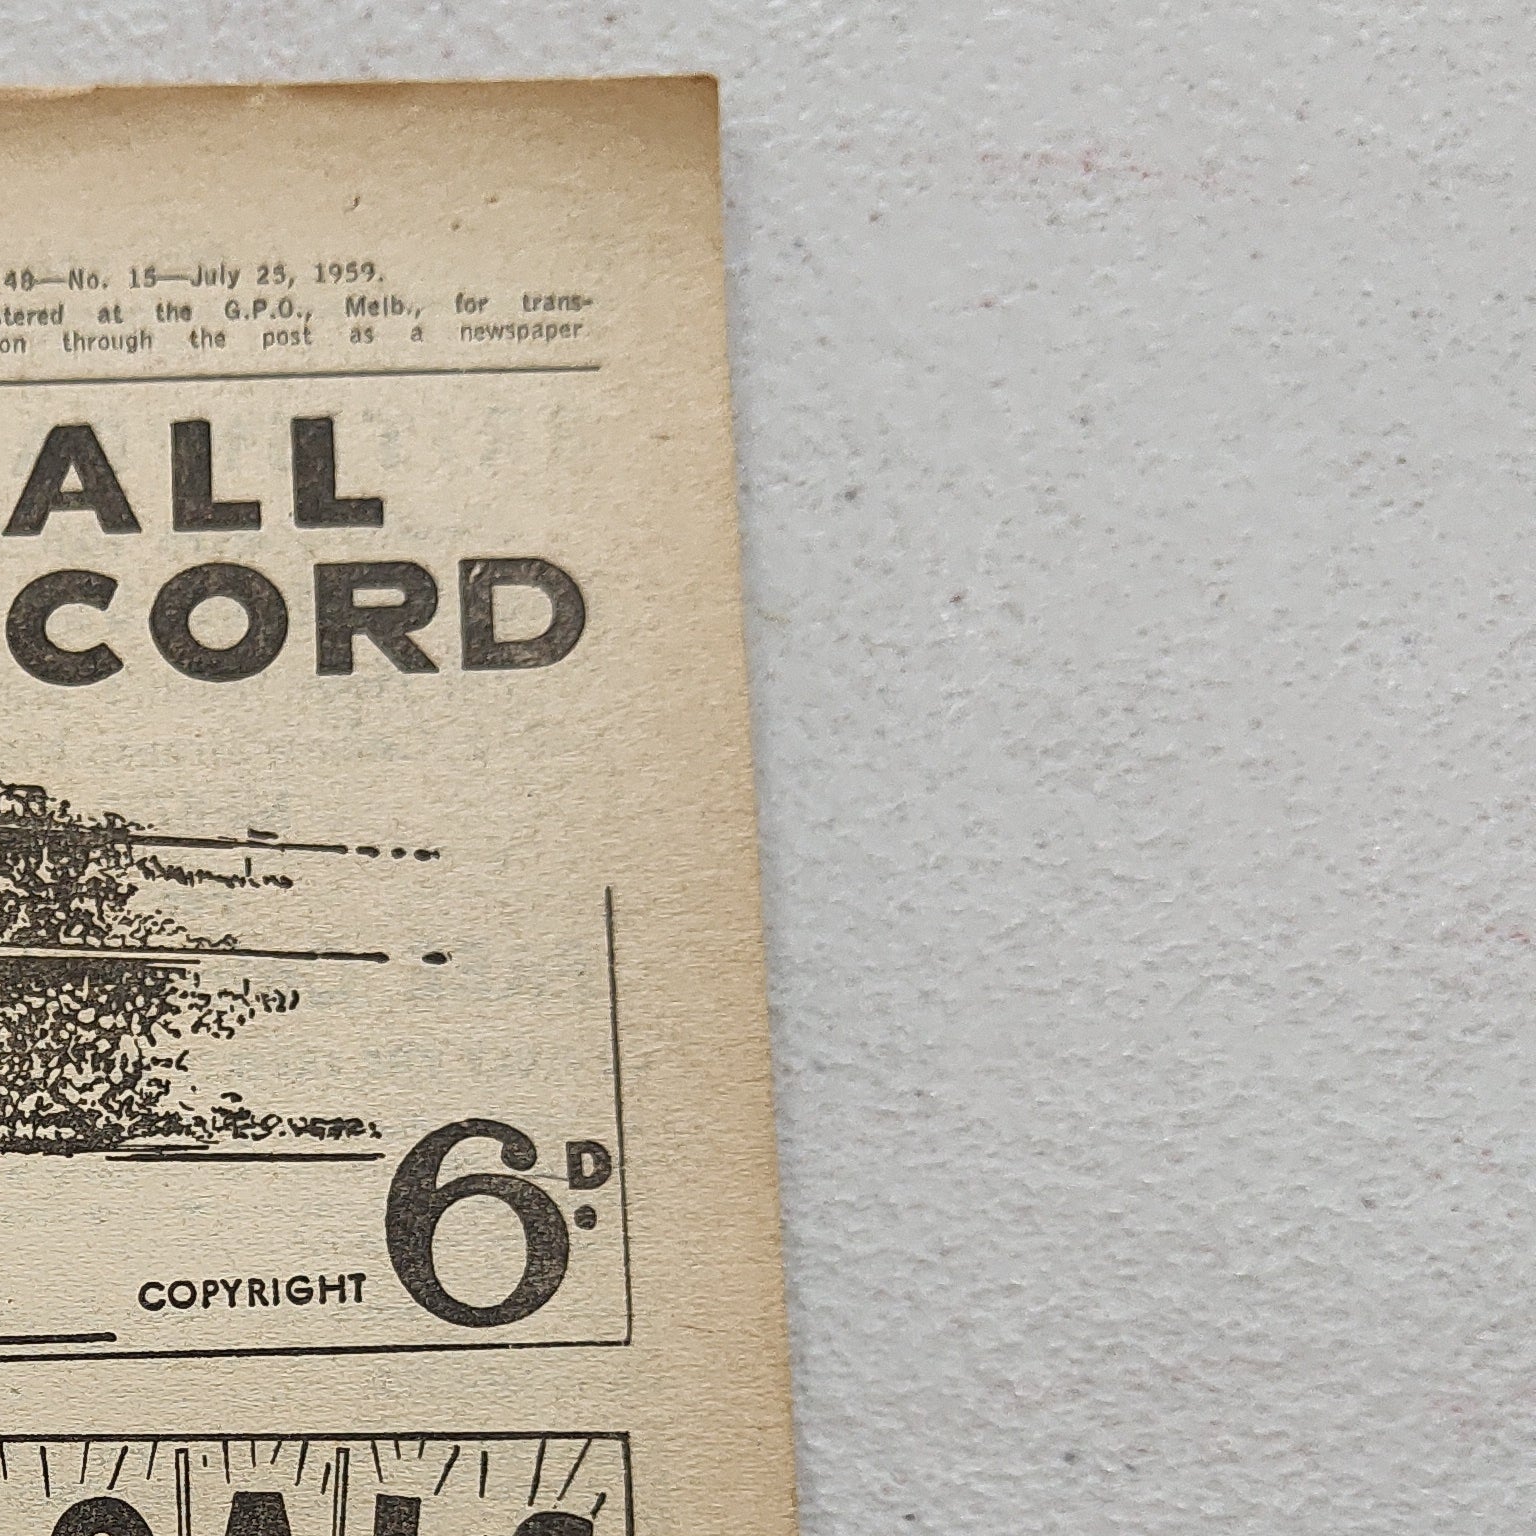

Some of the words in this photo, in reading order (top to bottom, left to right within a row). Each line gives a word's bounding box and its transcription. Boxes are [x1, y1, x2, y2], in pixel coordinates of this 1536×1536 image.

[314, 260, 384, 284] 1959.
[97, 303, 124, 324] at
[155, 300, 193, 323] the
[224, 295, 313, 324] G.P.O.,
[345, 294, 421, 320] Melb.,
[455, 291, 489, 315] for
[522, 292, 594, 313] trans-
[62, 327, 153, 354] through
[188, 326, 226, 350] the
[262, 323, 313, 351] post
[349, 325, 375, 345] as
[410, 325, 424, 343] a
[460, 321, 584, 343] newspaper
[137, 1272, 367, 1312] COPYRIGHT
